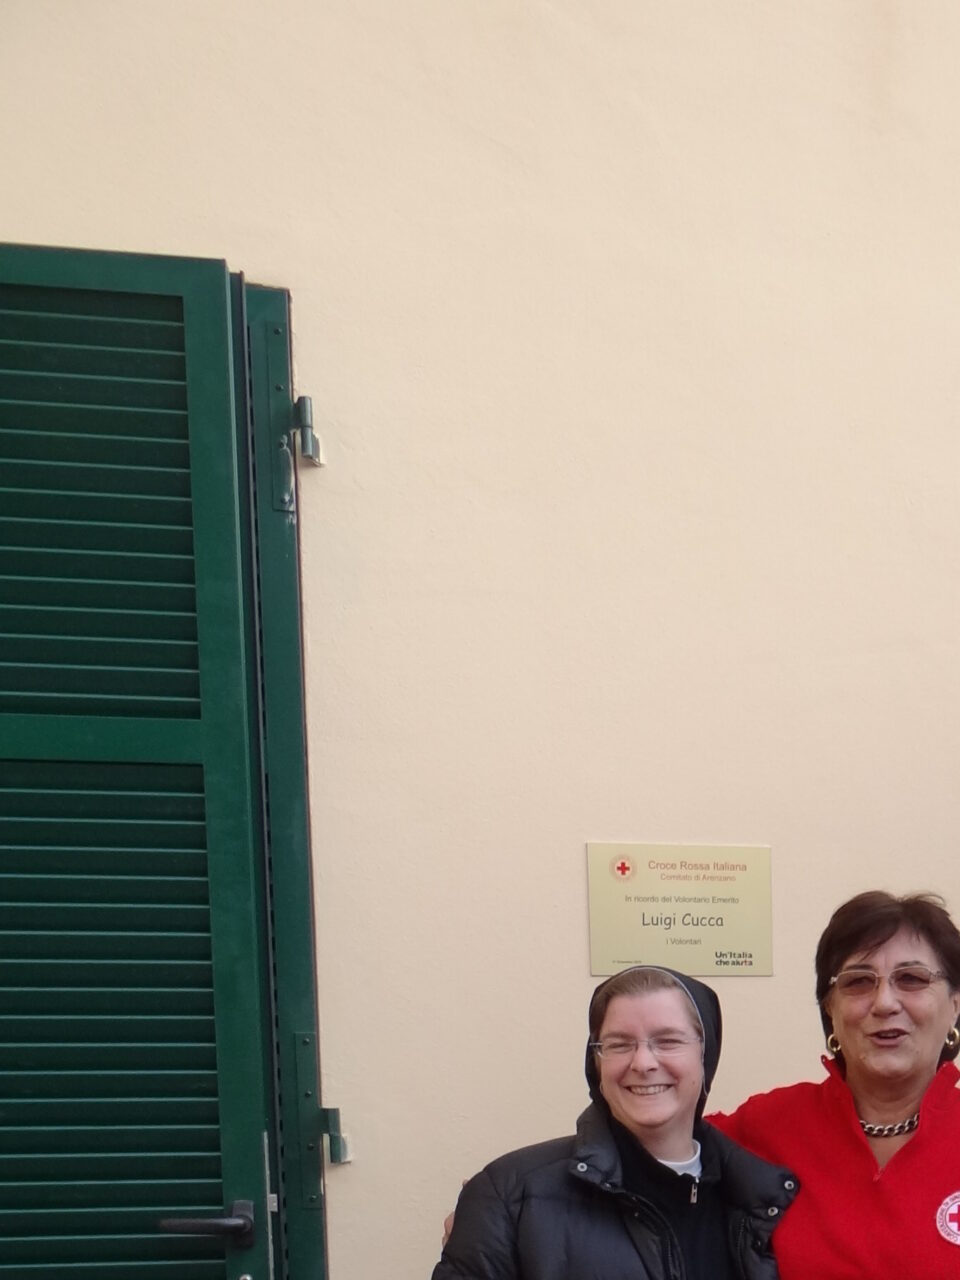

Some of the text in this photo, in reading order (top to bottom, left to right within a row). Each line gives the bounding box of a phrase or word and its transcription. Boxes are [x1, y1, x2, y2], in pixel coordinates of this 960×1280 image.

[648, 860, 747, 871] Croce Rossa Italiana
[660, 873, 692, 881] Comitato
[625, 895, 632, 903] In
[661, 895, 672, 903] del
[674, 896, 710, 904] Volontario
[642, 912, 724, 930] Luigi Cucca
